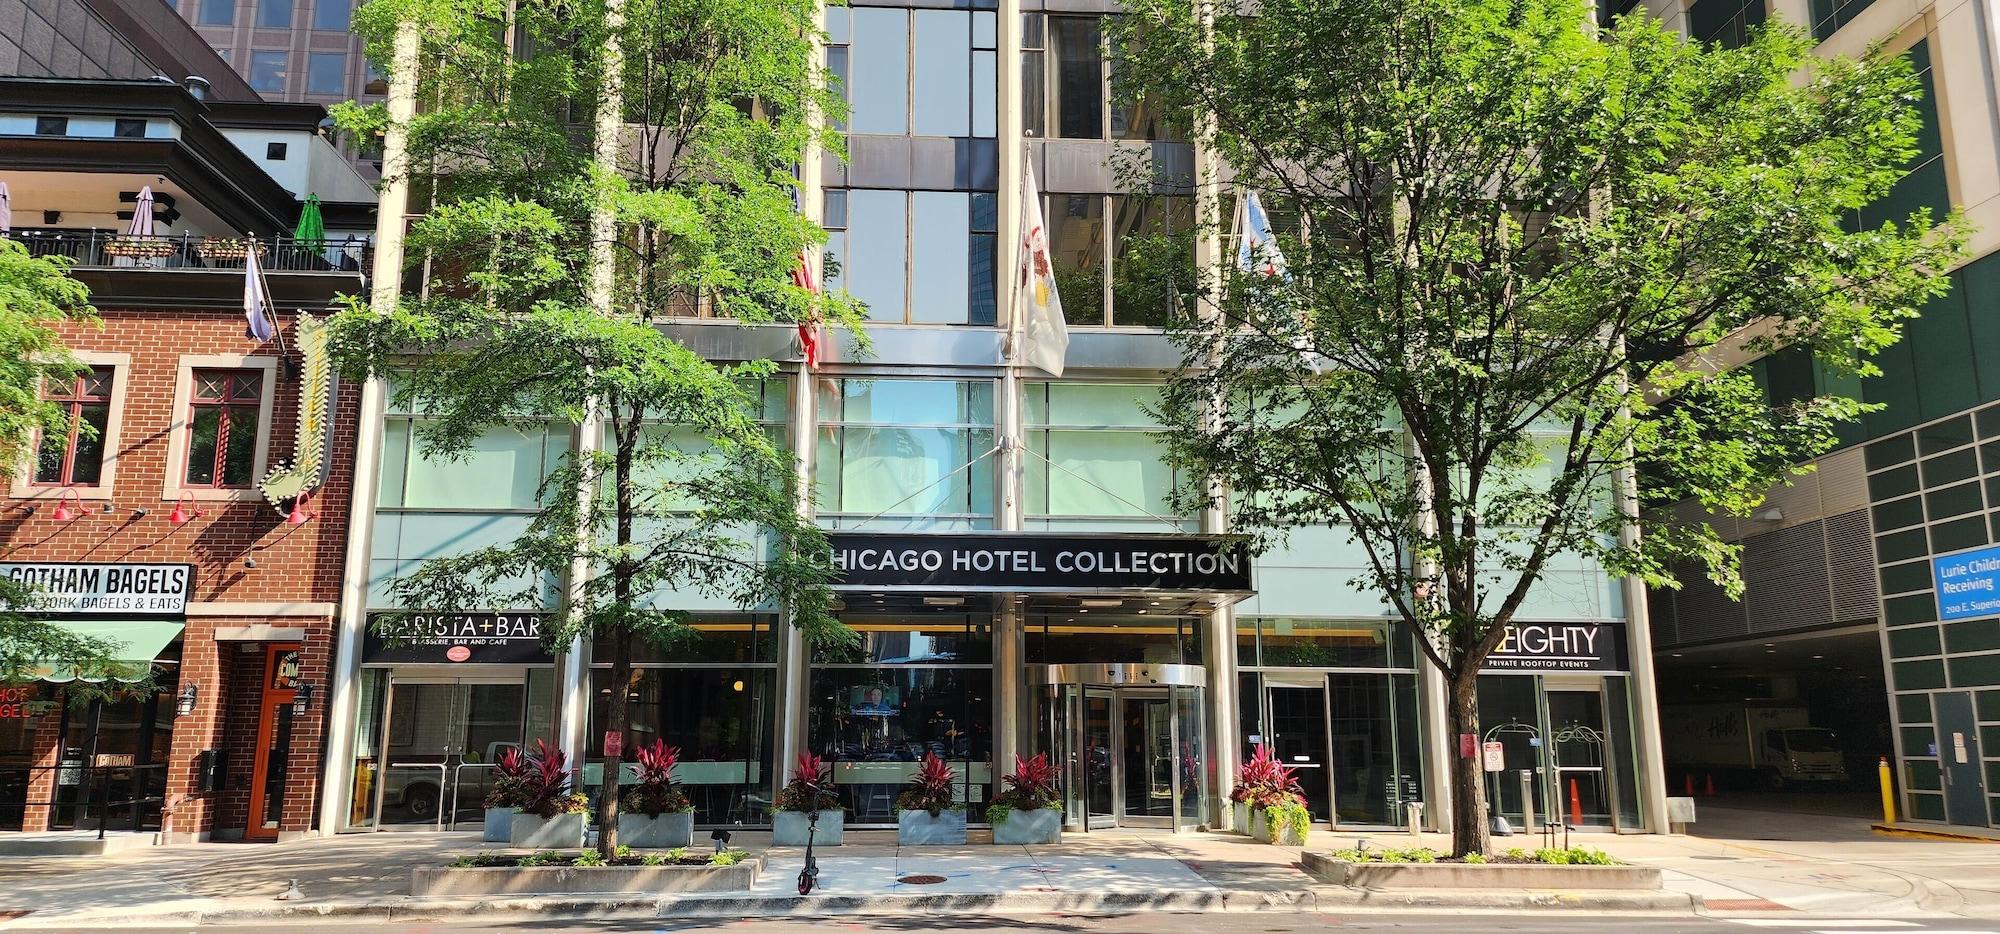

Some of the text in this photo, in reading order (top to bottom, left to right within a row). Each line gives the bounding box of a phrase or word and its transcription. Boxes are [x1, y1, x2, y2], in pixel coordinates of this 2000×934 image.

[808, 549, 1239, 575] CHICAGO HOTEL COLLECTION
[1940, 563, 1967, 578] Lurie
[9, 567, 184, 594] GOTHAM BAGELS
[1942, 577, 1994, 594] Receiving
[81, 597, 131, 609] BAGELS
[135, 597, 144, 609] &
[150, 598, 181, 610] EATS
[1946, 605, 1960, 614] 200
[1970, 598, 2000, 611] Superio
[285, 651, 298, 661] THE
[1521, 660, 1557, 668] ROOFTOP
[99, 754, 132, 766] GOTHAM
